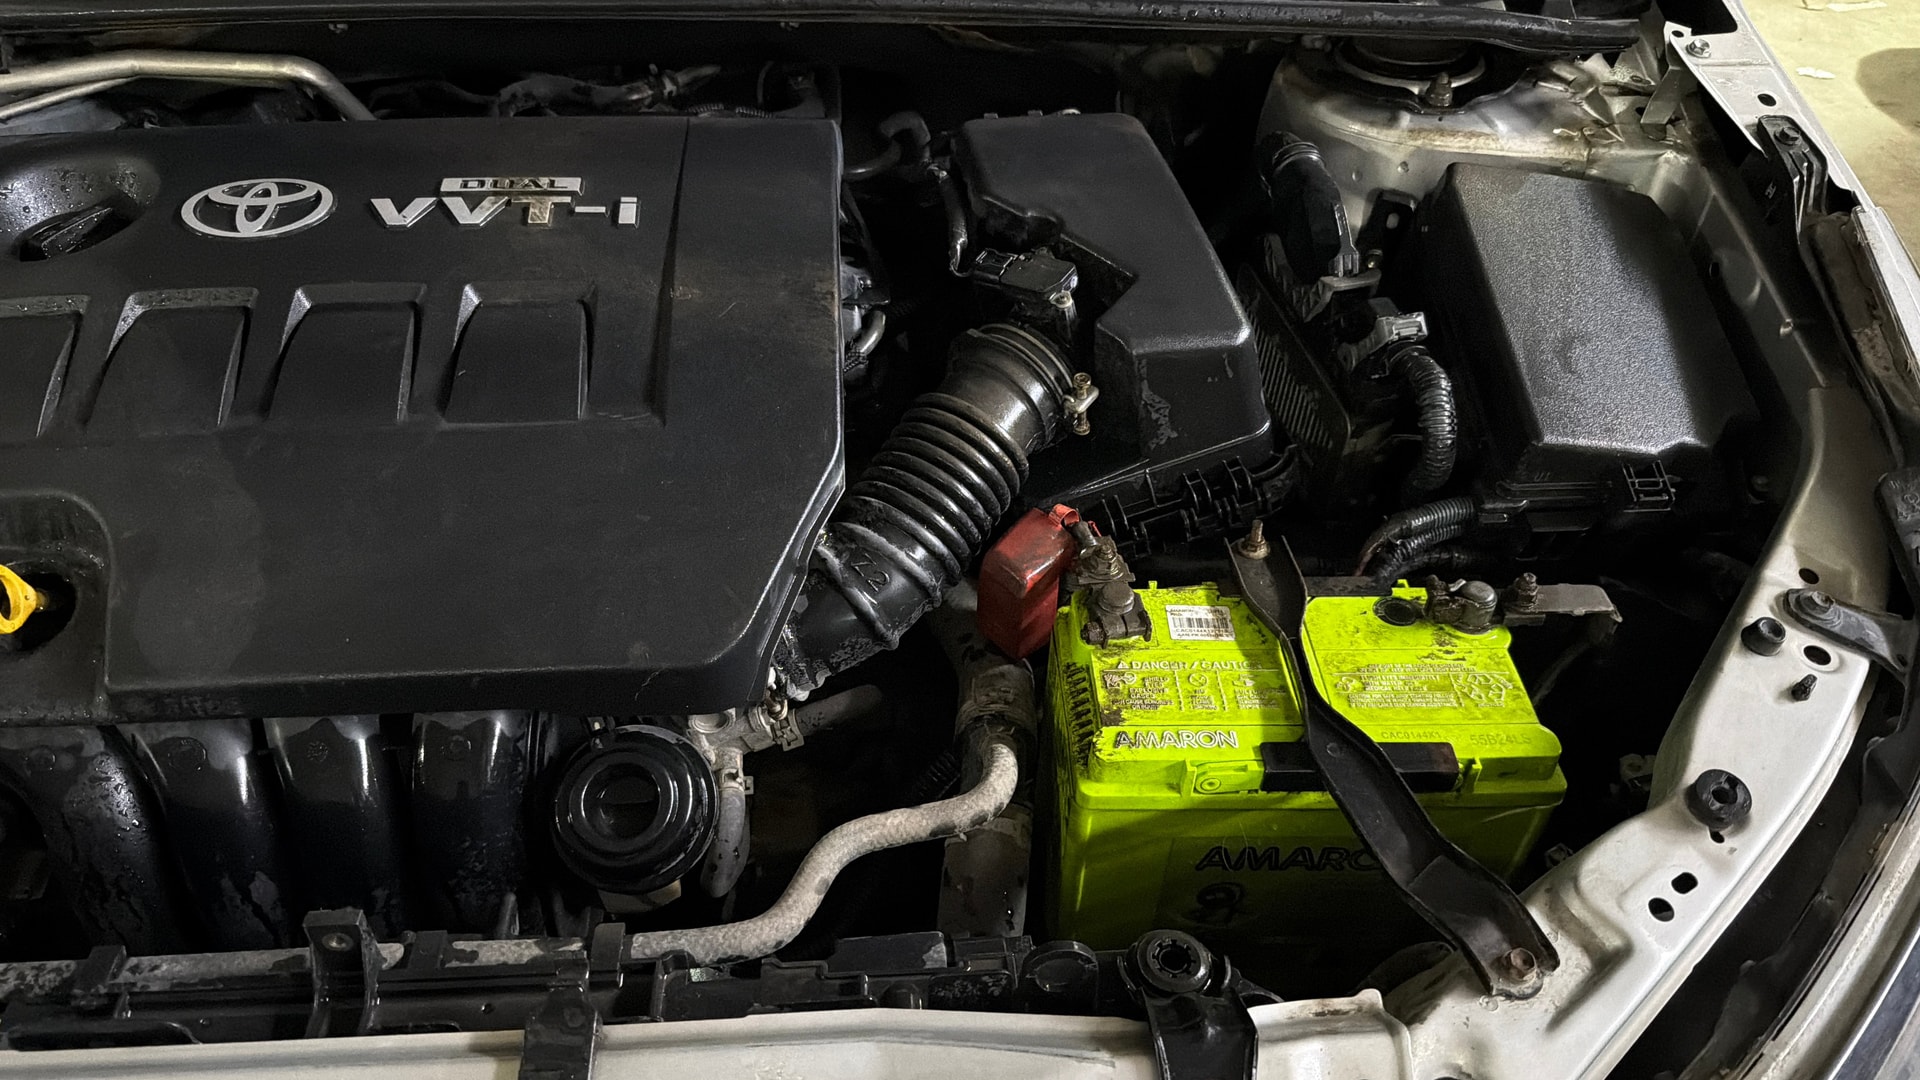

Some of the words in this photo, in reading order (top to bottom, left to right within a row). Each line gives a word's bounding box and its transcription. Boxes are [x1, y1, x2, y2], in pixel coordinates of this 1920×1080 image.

[459, 177, 569, 190] DUAL
[370, 195, 640, 228] VVT-i
[1131, 660, 1188, 670] DANGER
[1114, 729, 1240, 749] AMARON
[1195, 845, 1384, 871] AMARO
